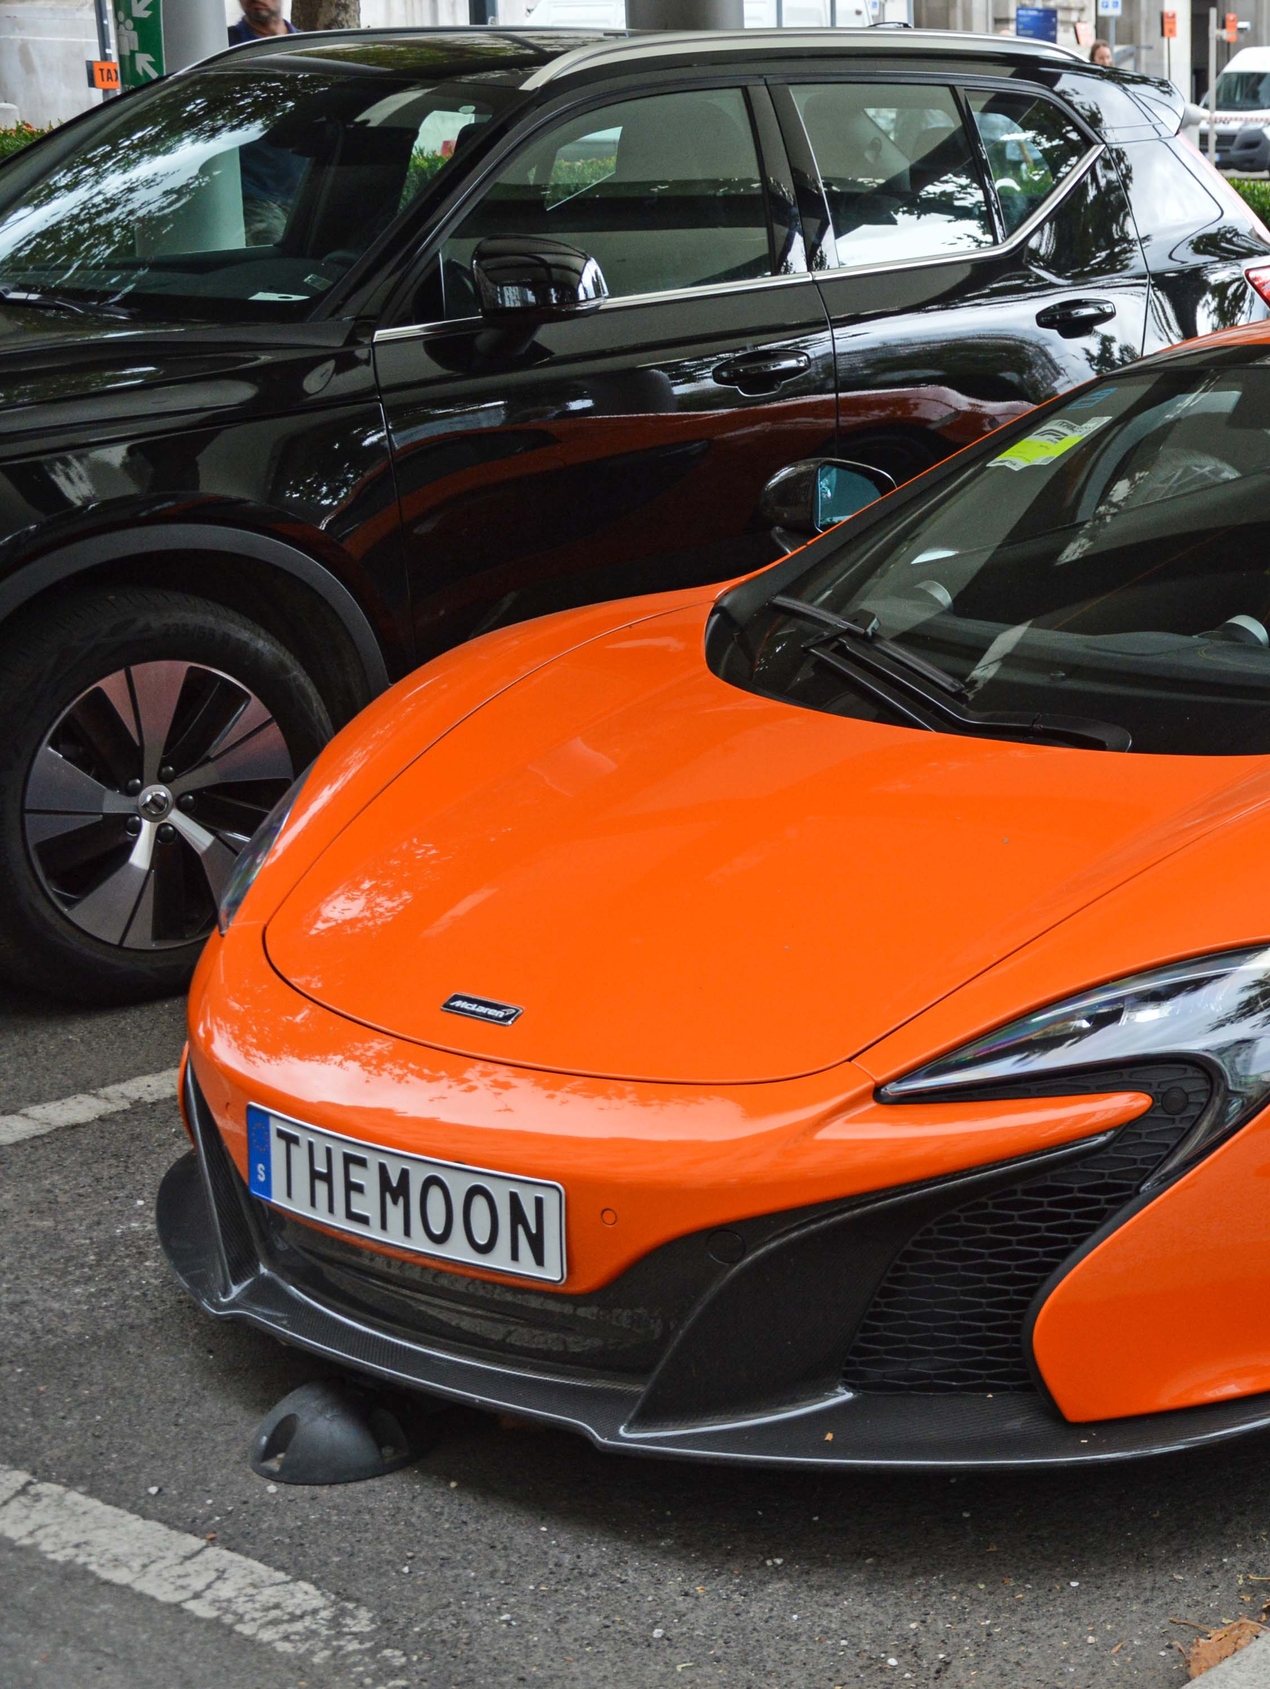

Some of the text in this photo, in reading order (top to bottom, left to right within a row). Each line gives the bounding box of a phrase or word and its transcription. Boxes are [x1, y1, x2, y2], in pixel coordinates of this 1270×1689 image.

[449, 1000, 505, 1018] McLaren
[257, 1163, 266, 1181] S
[276, 1125, 545, 1268] THEMOON
